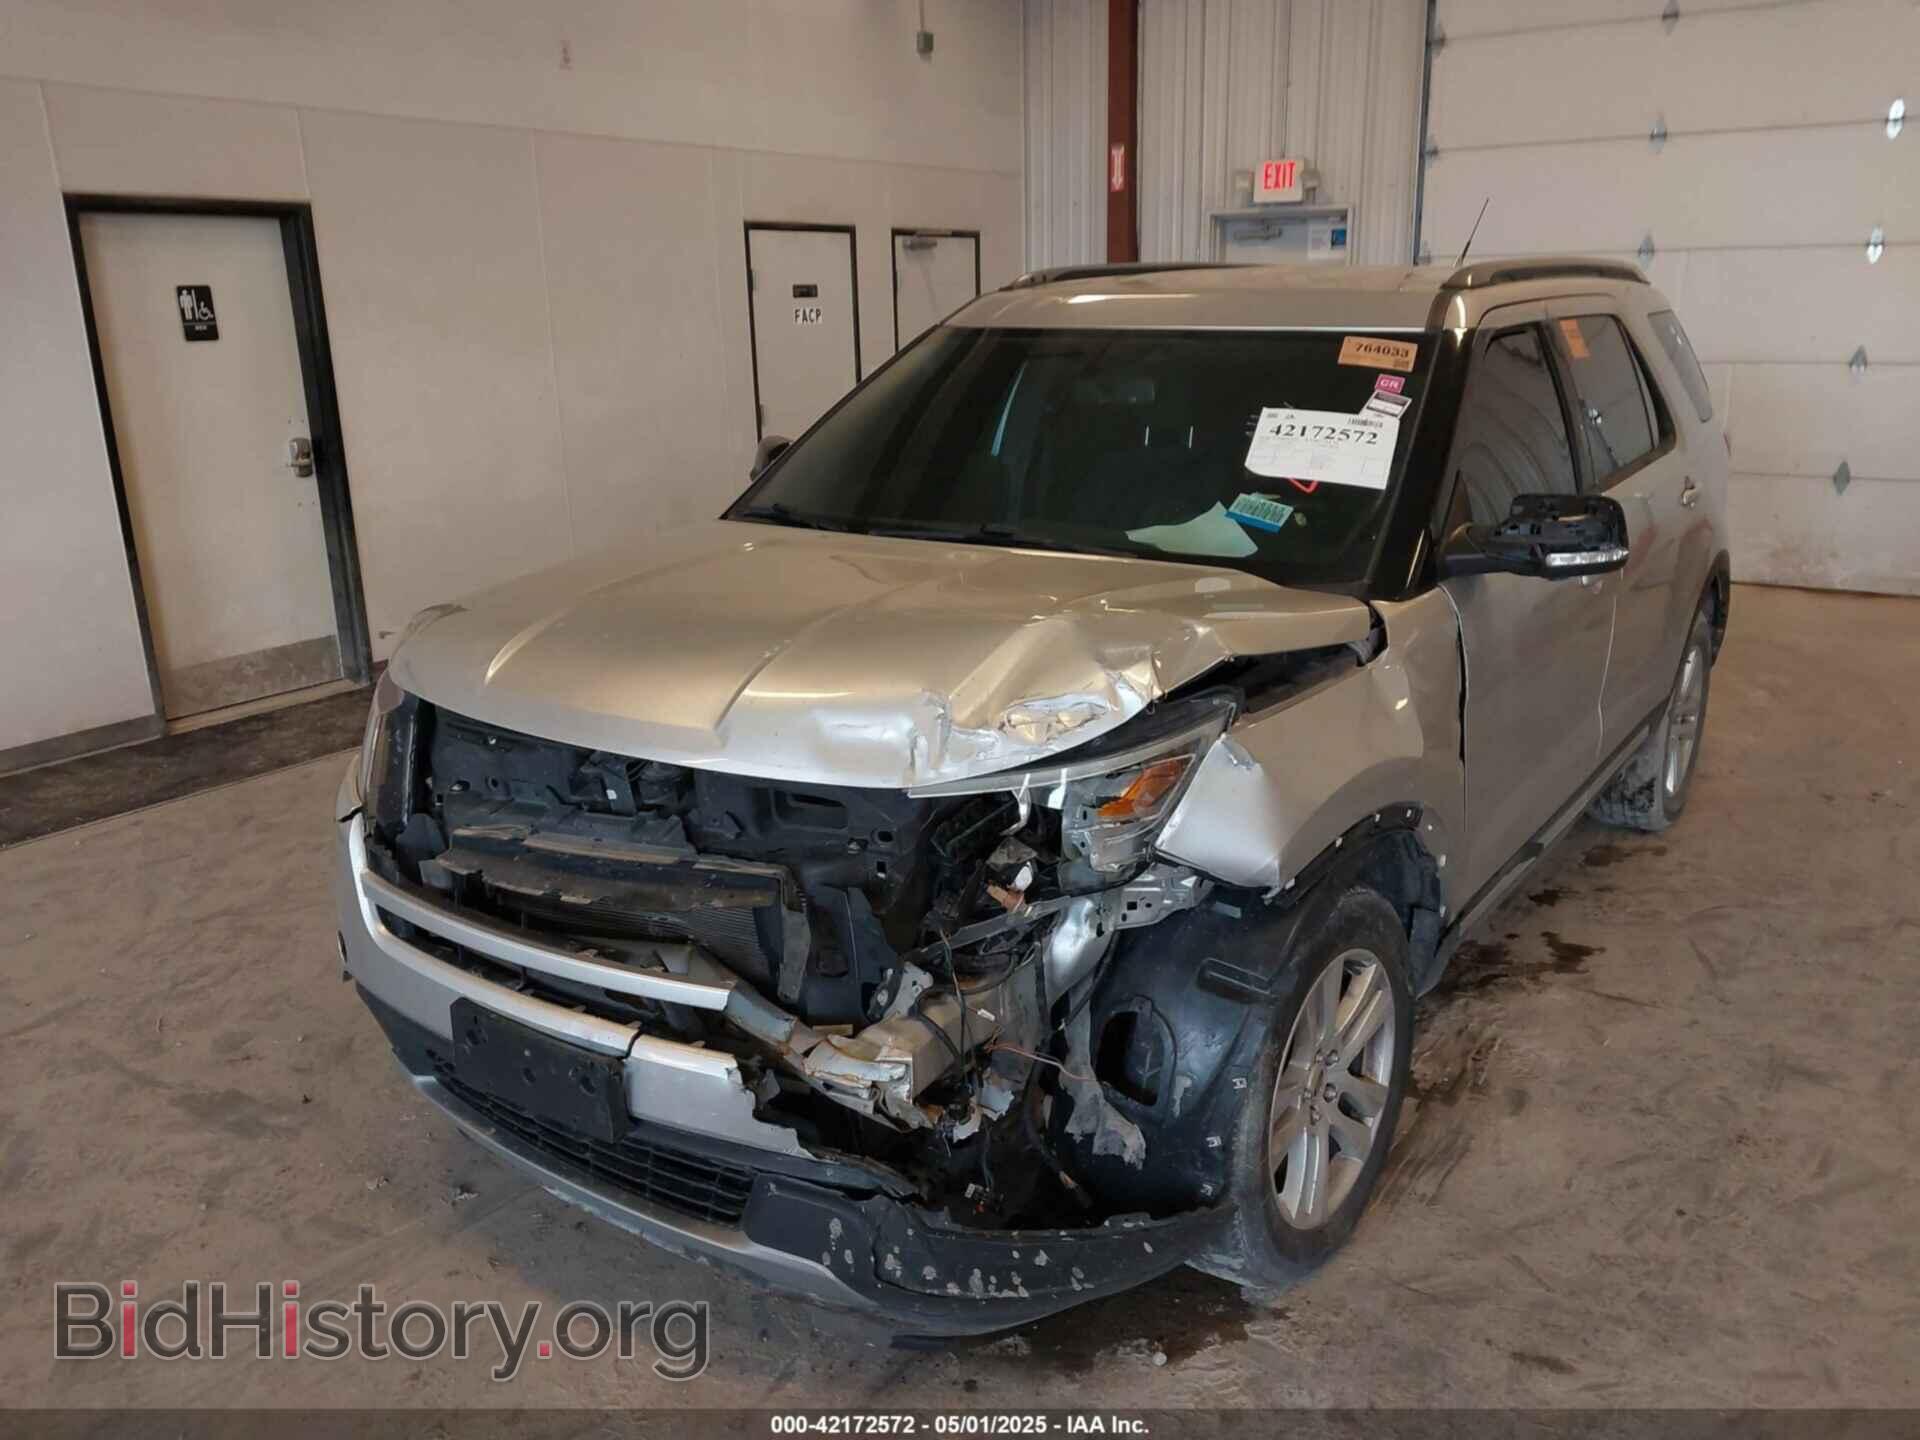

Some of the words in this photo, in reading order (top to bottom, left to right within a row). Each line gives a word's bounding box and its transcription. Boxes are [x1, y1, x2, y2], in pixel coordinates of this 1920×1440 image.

[1264, 162, 1295, 190] EXIT
[794, 308, 822, 323] FACP
[1355, 343, 1409, 358] 764033
[1269, 423, 1378, 445] 42172572
